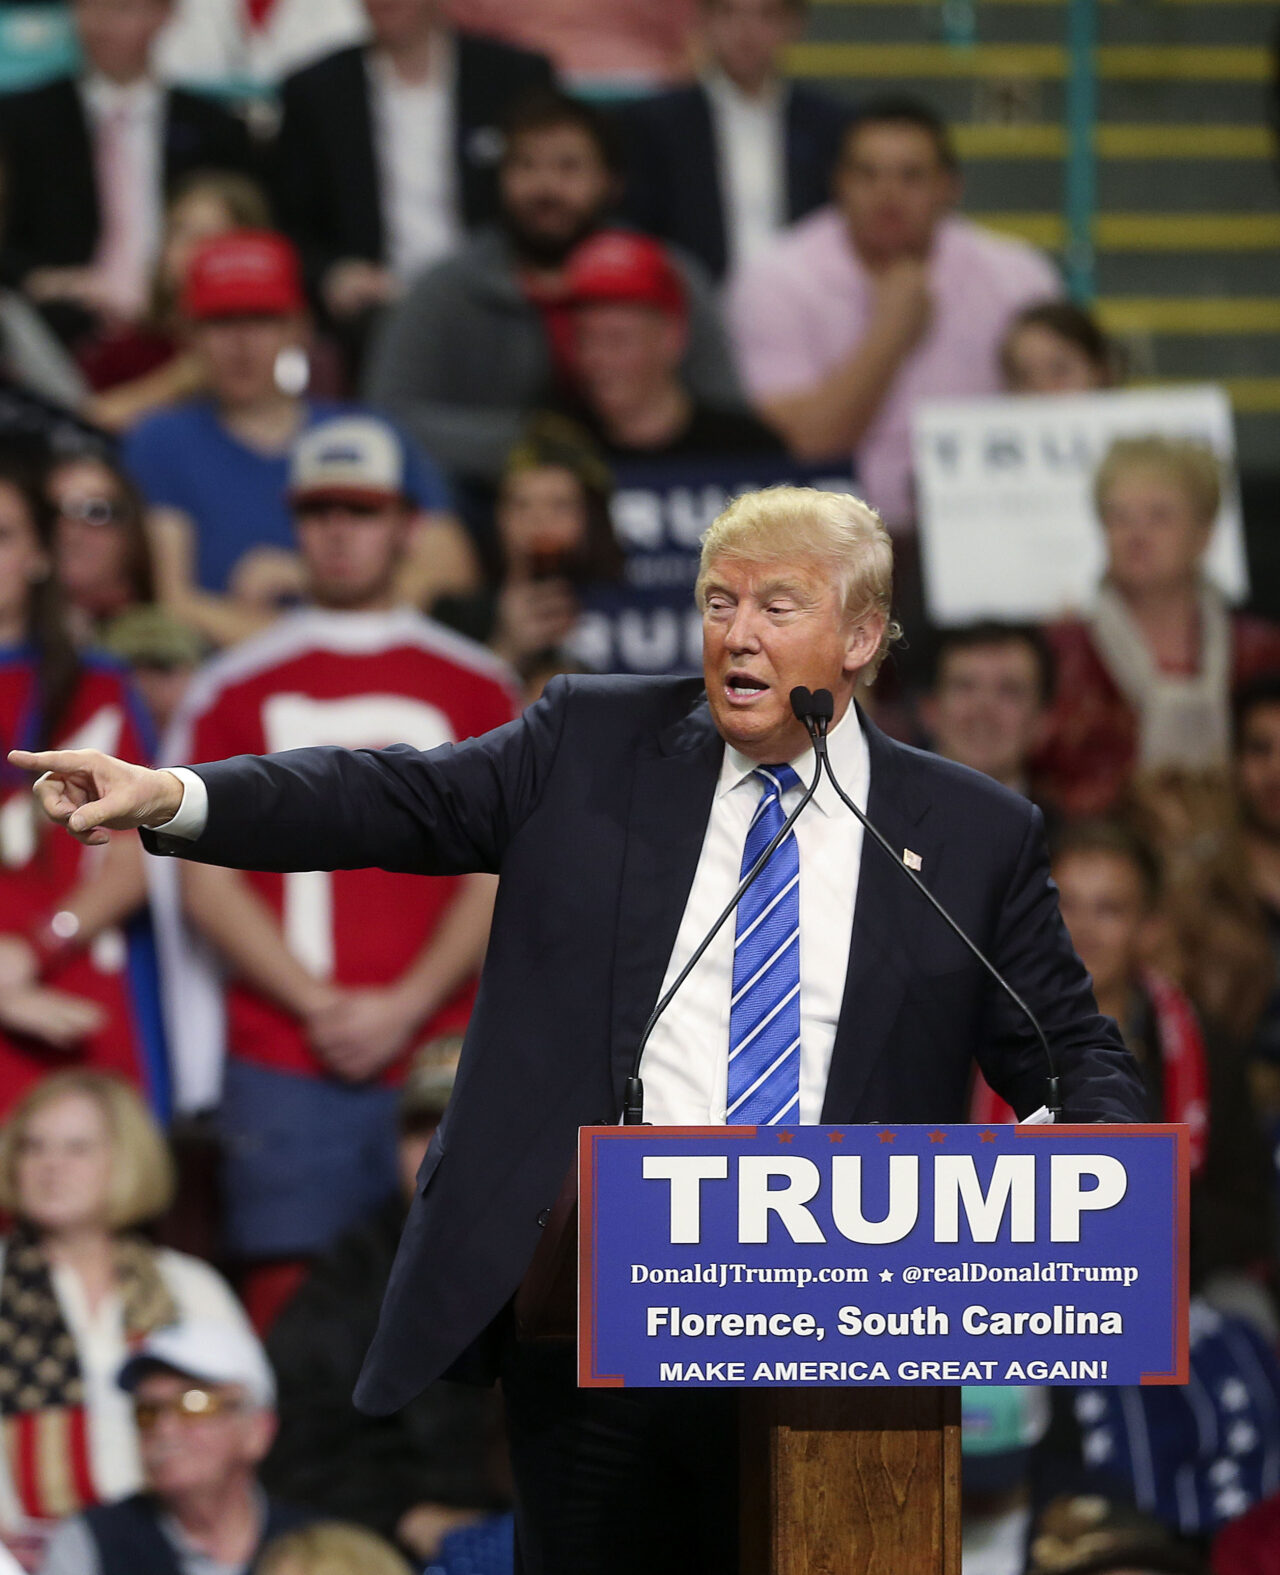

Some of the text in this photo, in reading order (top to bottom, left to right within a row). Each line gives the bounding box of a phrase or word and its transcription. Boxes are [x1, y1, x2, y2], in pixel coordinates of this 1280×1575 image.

[642, 1153, 1129, 1245] TRUMP
[630, 1262, 1139, 1288] DonaldJTrump.com @realDonaldTrump
[646, 1305, 1123, 1342] Florence, South Carolina
[659, 1360, 1109, 1382] MAKE AMERICA GREAT AGAIN!
